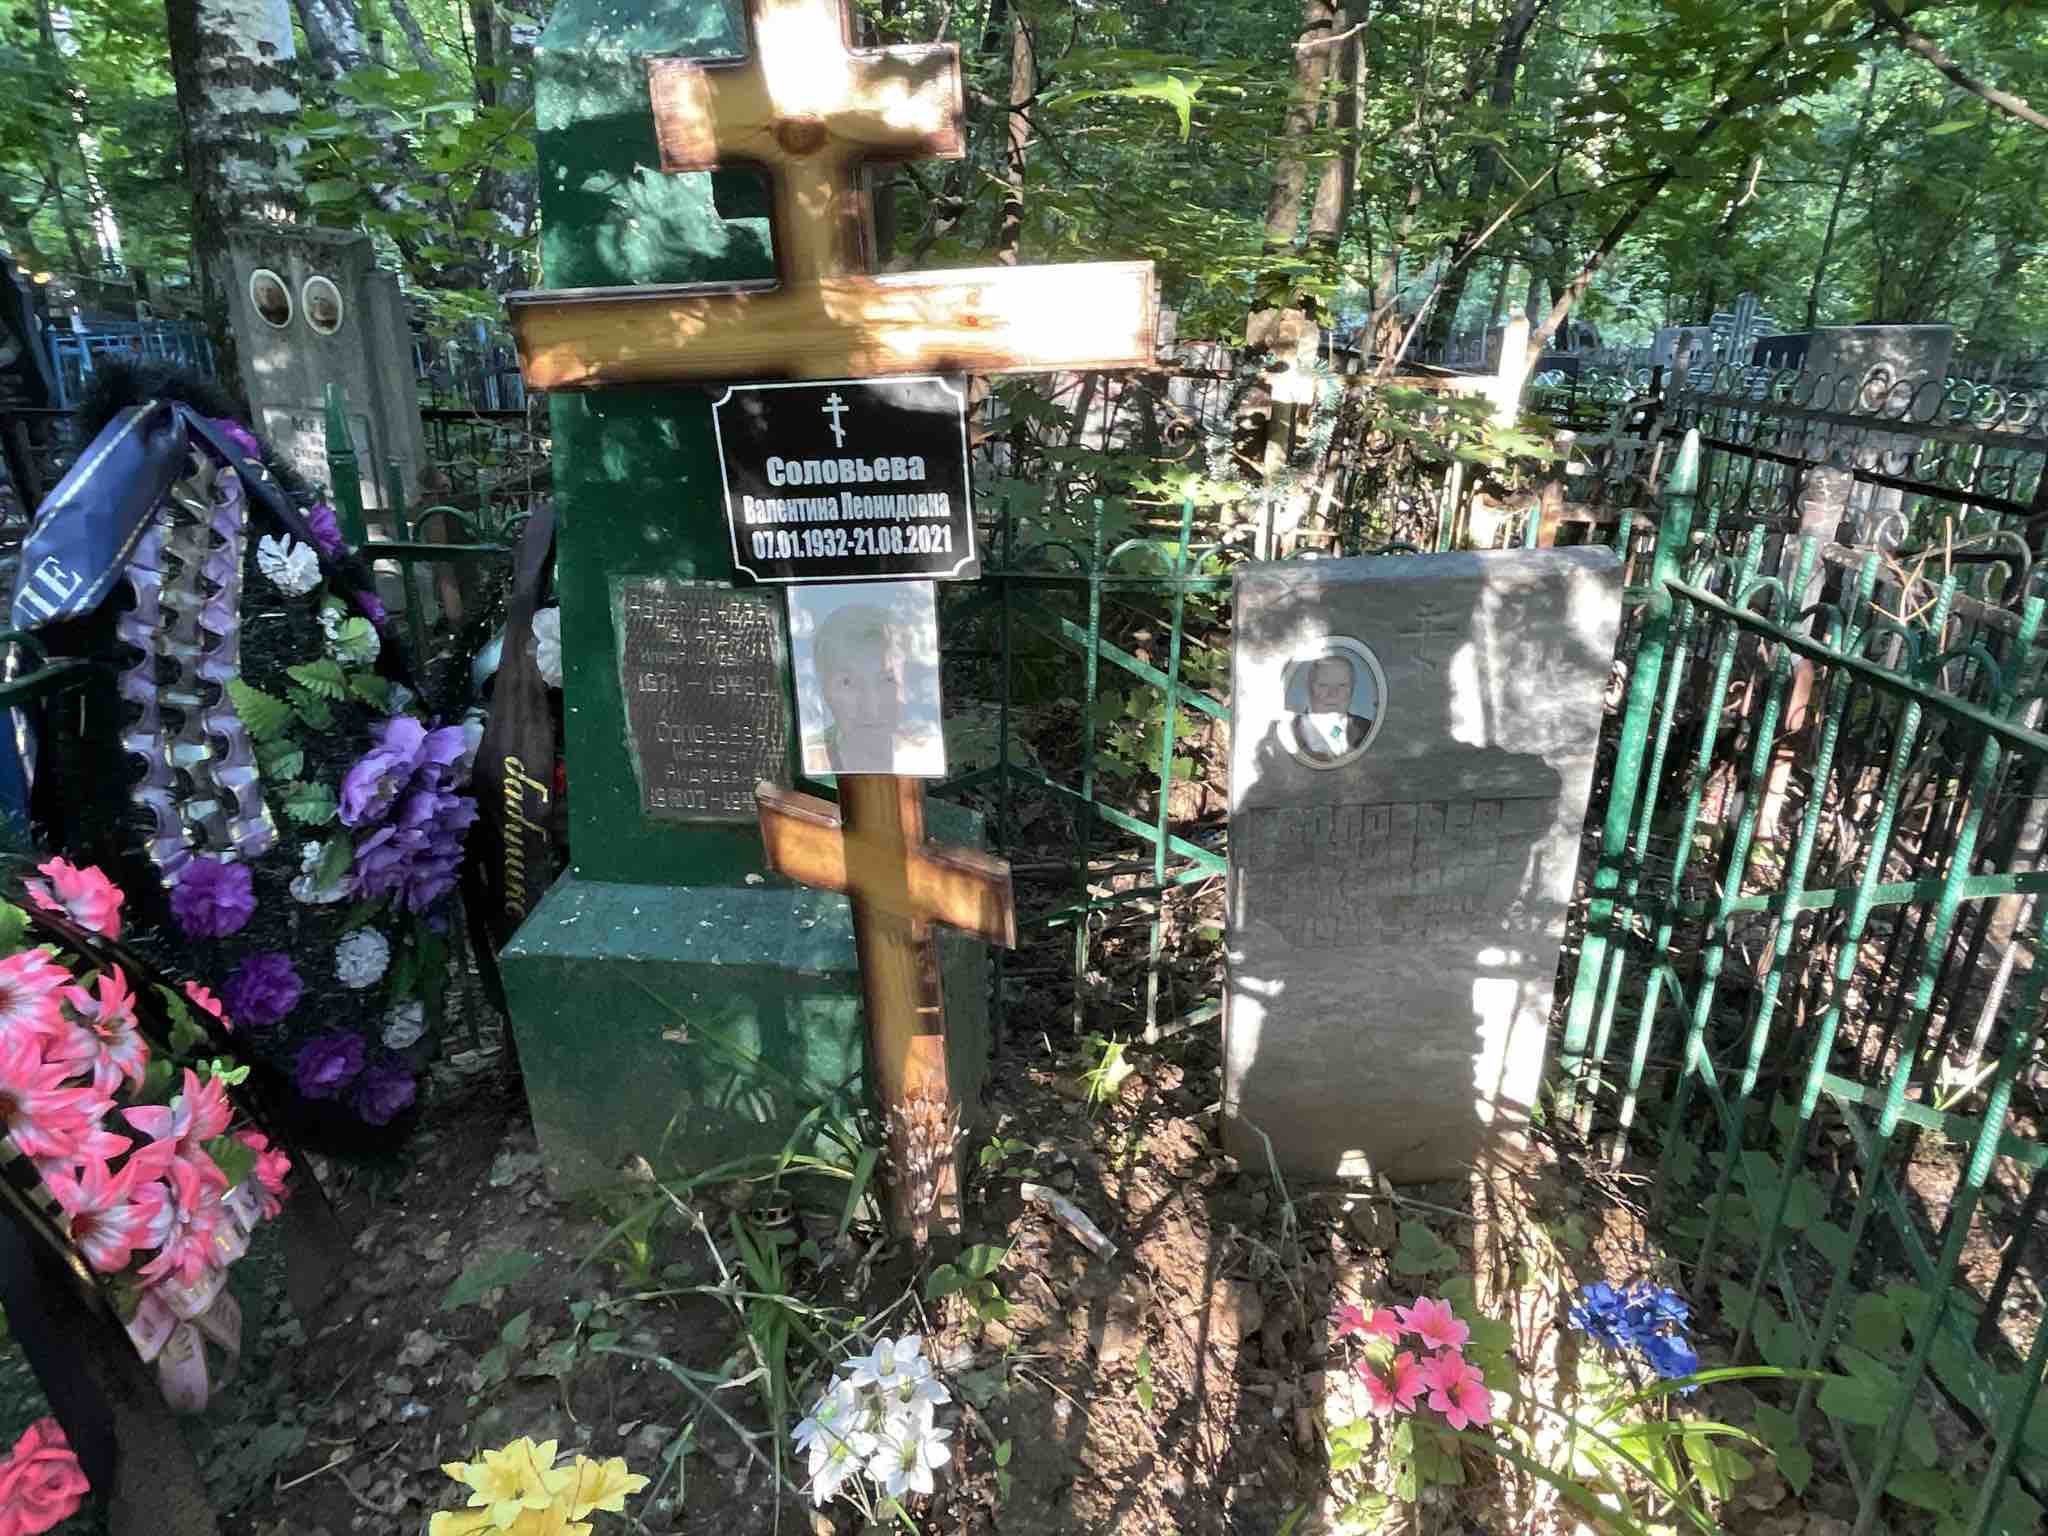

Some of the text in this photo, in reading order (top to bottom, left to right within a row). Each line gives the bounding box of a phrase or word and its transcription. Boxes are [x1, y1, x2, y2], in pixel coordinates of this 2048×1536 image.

[766, 456, 926, 486] Соловьева
[743, 492, 951, 524] Валентина Леонидовна
[751, 525, 953, 560] 07.01.1932-21.08.2021
